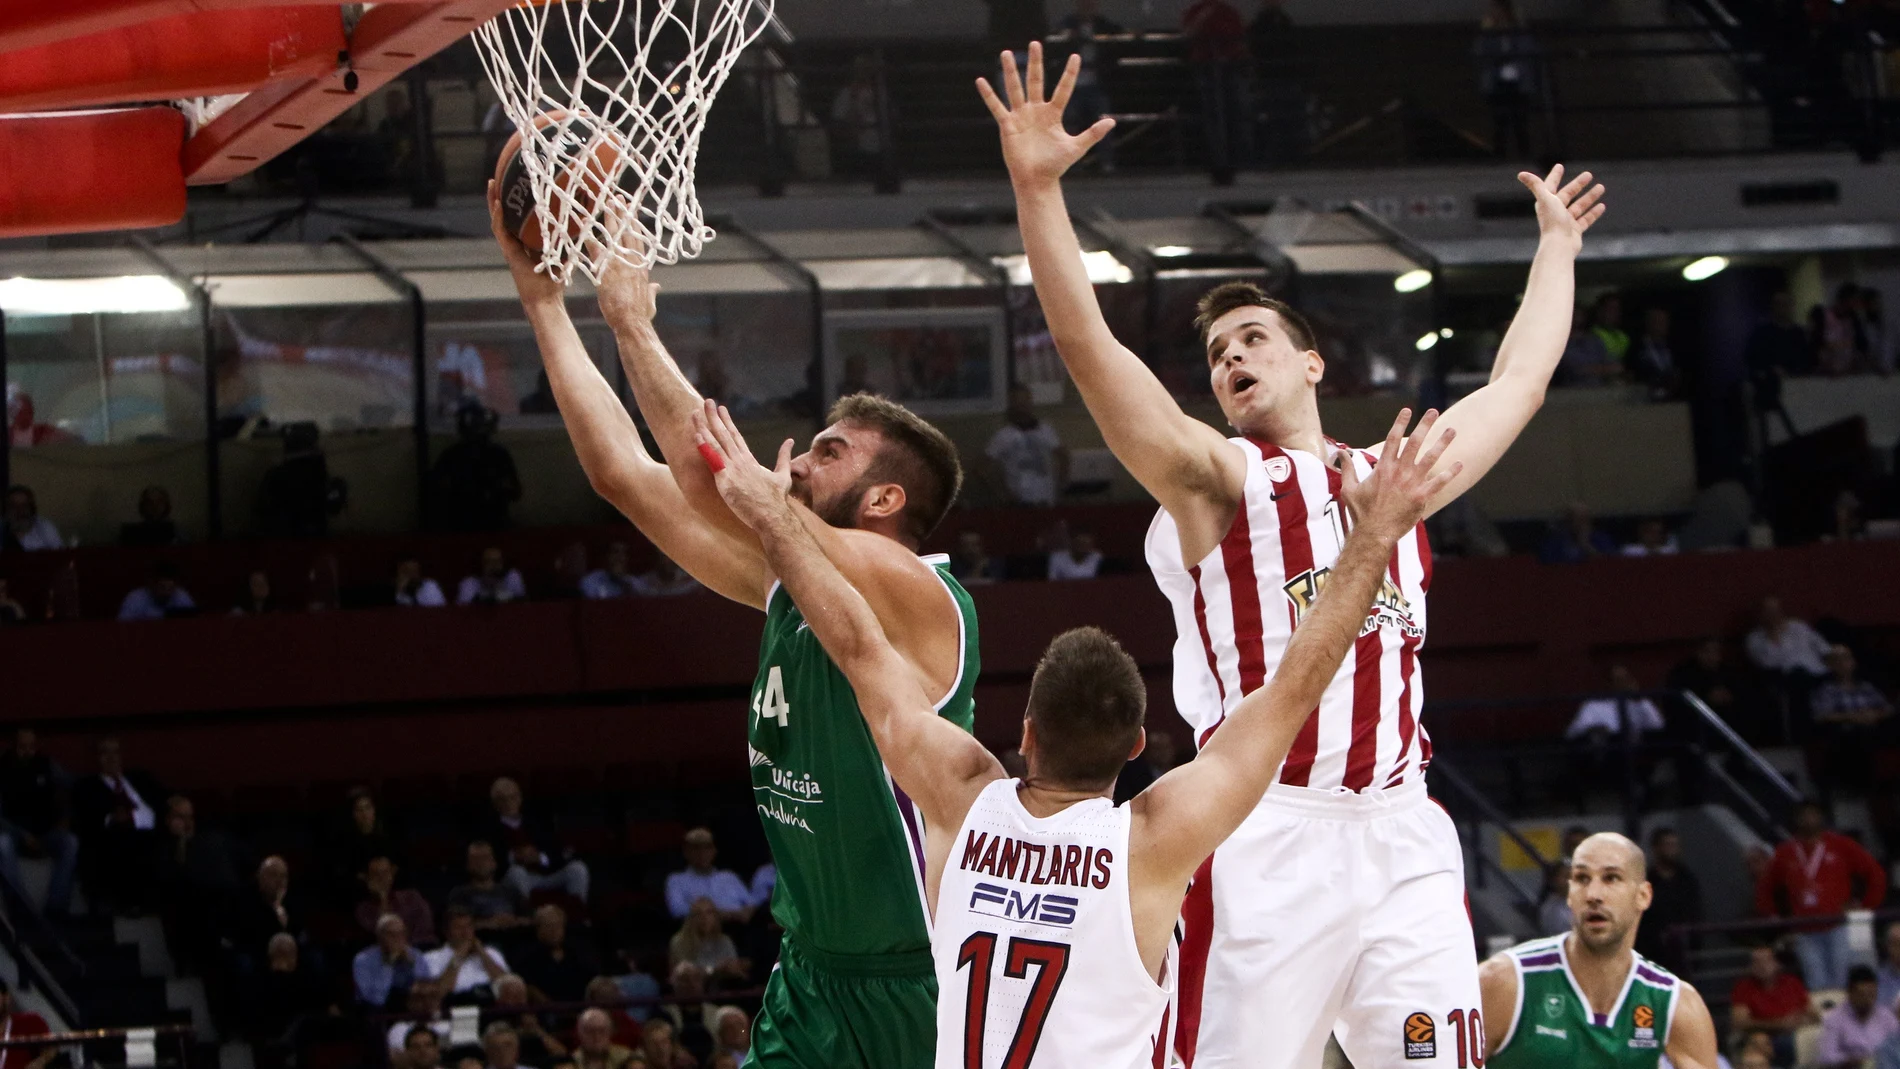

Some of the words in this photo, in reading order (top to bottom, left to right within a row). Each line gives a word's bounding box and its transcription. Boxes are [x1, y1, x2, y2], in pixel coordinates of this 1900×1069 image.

[772, 767, 822, 799] Unicaja
[960, 829, 1113, 890] MANTZARIS
[969, 882, 1079, 925] FMS
[955, 930, 1072, 1069] 17
[1447, 1008, 1485, 1069] 10
